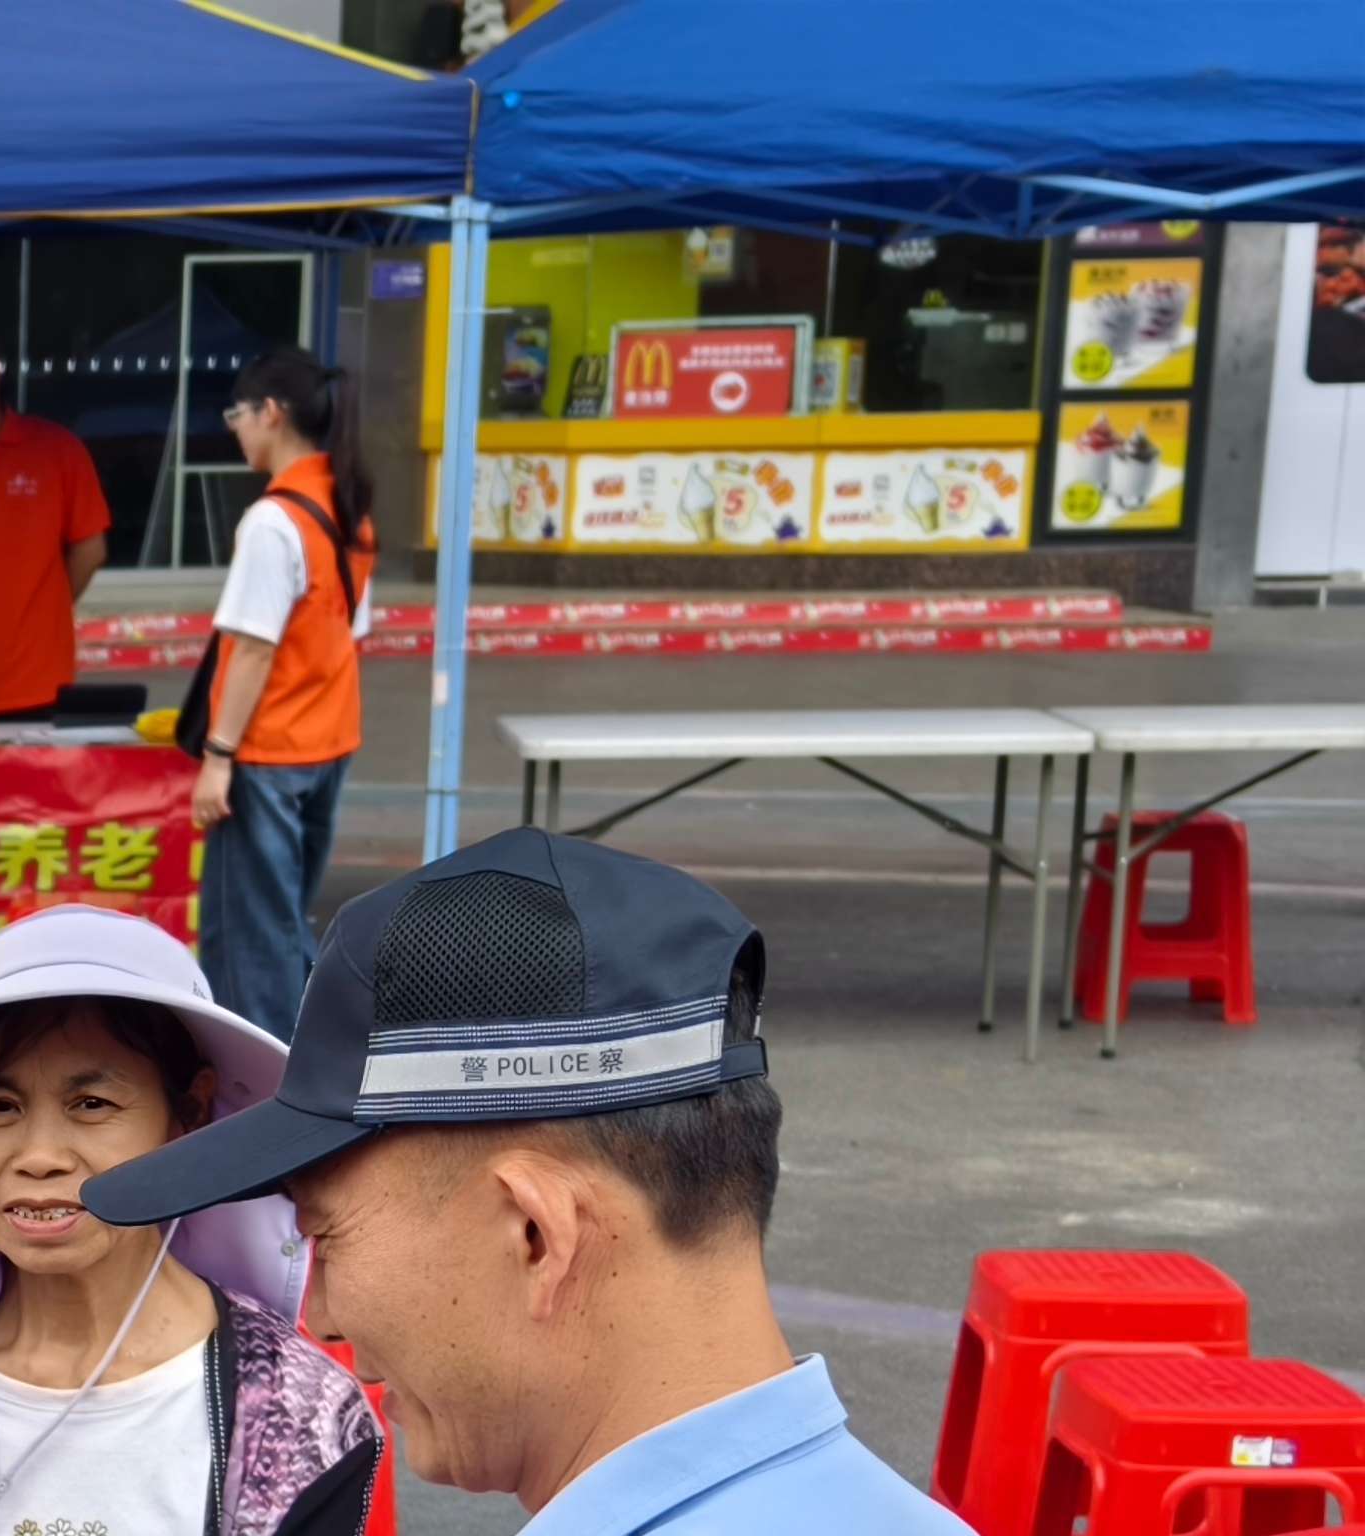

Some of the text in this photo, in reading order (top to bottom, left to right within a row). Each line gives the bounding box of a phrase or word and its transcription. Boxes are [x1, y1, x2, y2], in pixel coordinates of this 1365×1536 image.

[461, 1048, 624, 1083] 警 POLICE 察
